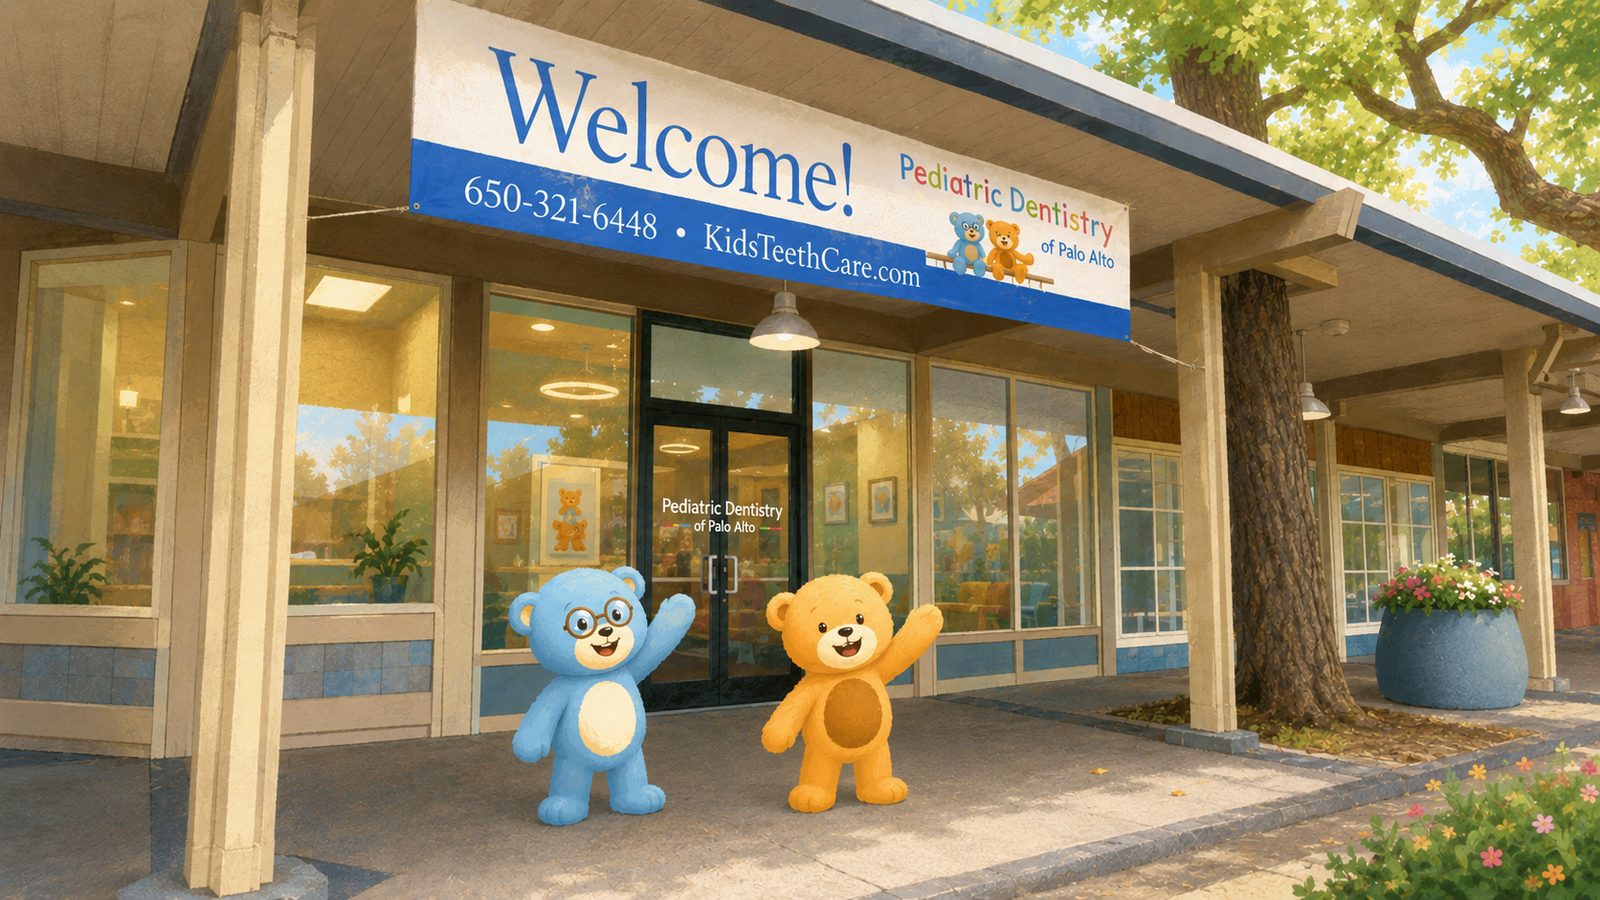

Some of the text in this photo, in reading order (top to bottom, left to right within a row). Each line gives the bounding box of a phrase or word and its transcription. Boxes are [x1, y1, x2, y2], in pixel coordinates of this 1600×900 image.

[488, 46, 853, 217] Welcome!
[464, 175, 921, 287] 650-321-6448 KidsTeethCare.com
[900, 153, 1113, 248] Pediatric Dentistry
[1041, 239, 1115, 269] of Palo Alto
[662, 498, 783, 521] Pediatric Dentistry
[694, 519, 756, 533] of Palo Alto
